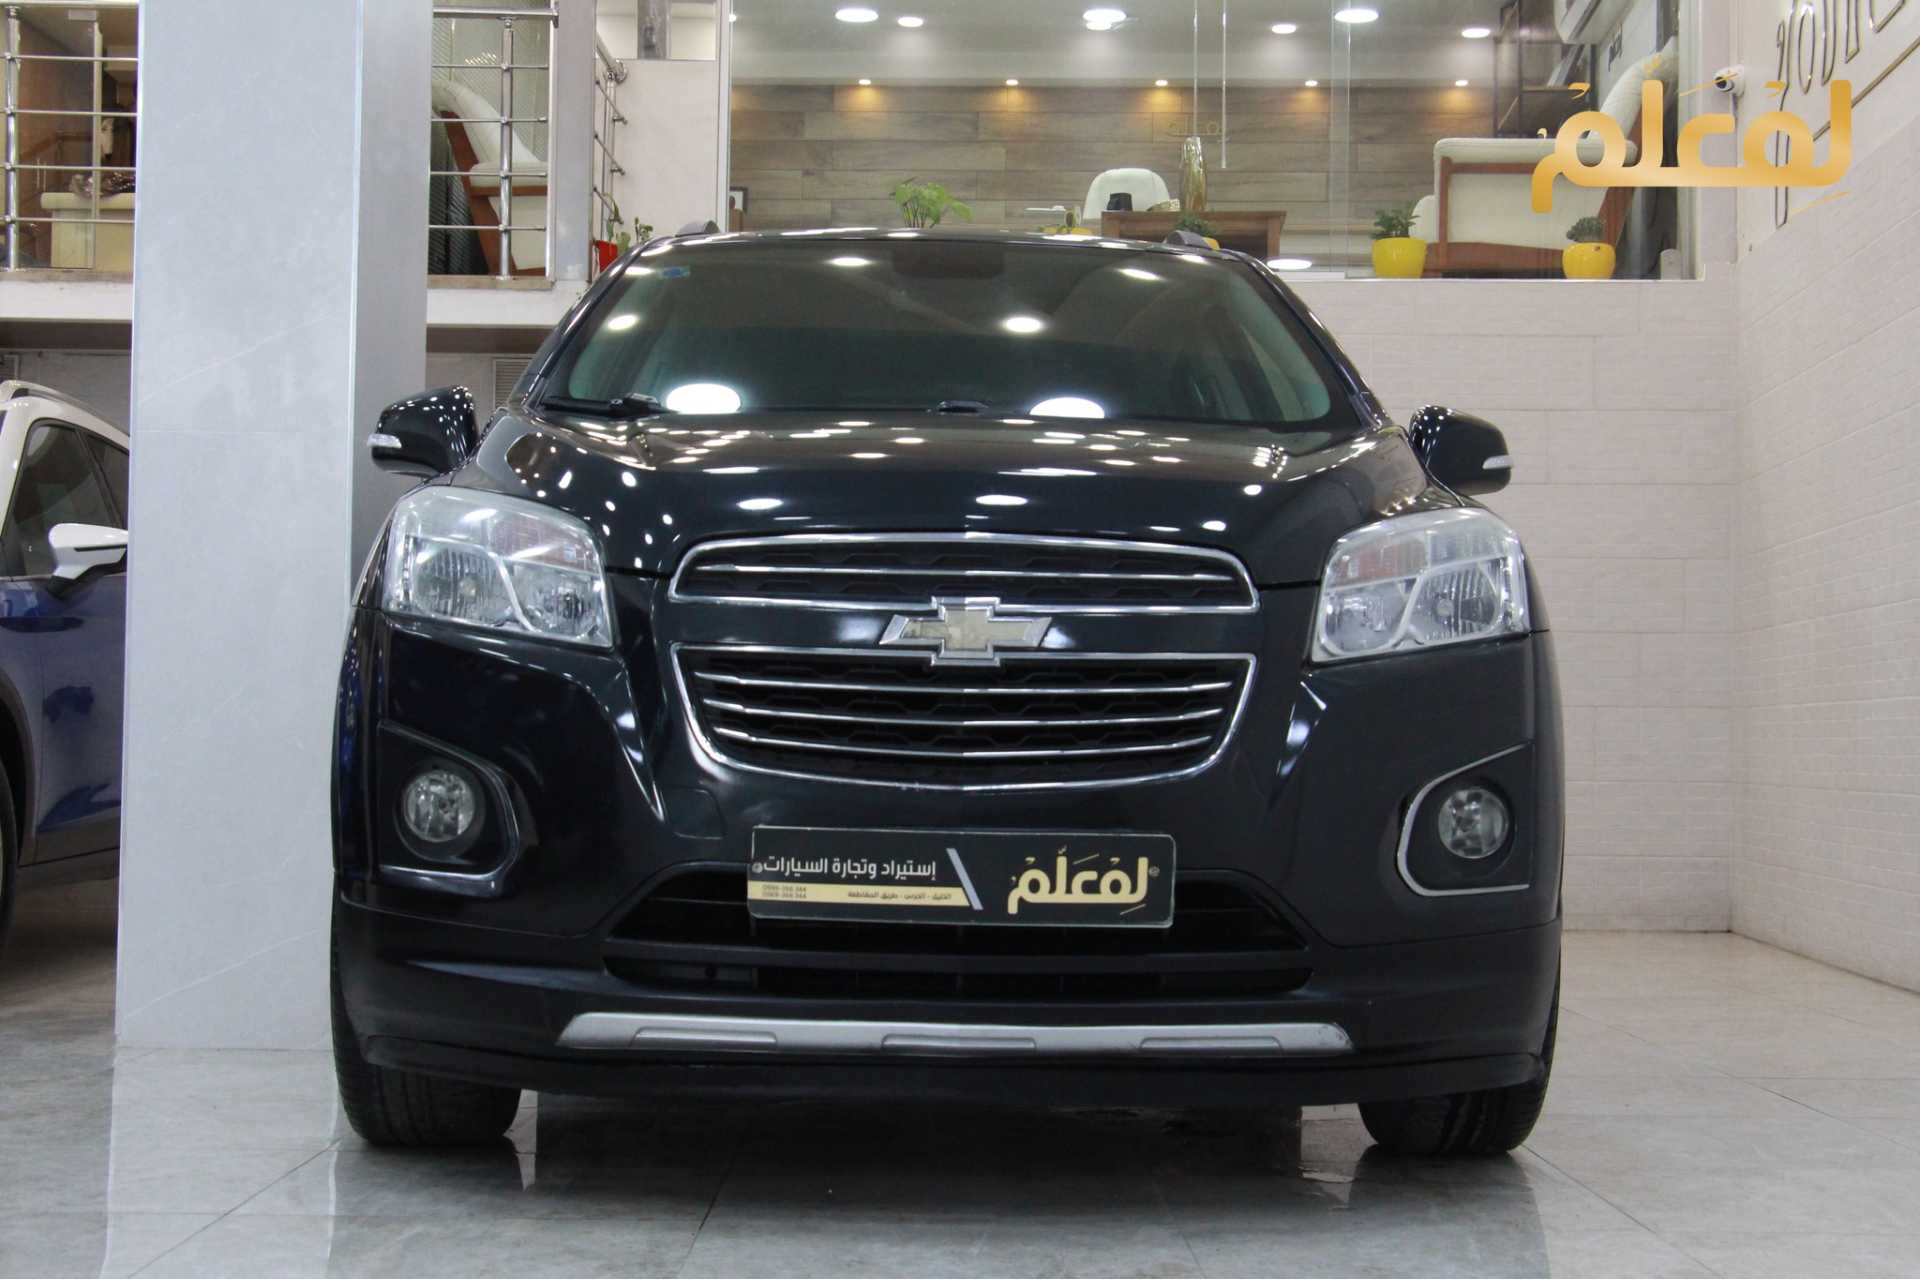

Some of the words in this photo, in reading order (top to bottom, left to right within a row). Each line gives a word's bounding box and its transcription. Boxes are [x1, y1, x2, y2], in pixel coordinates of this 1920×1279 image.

[763, 856, 828, 877] السيارات
[832, 858, 877, 880] وتجارة
[881, 860, 937, 881] إستيراد
